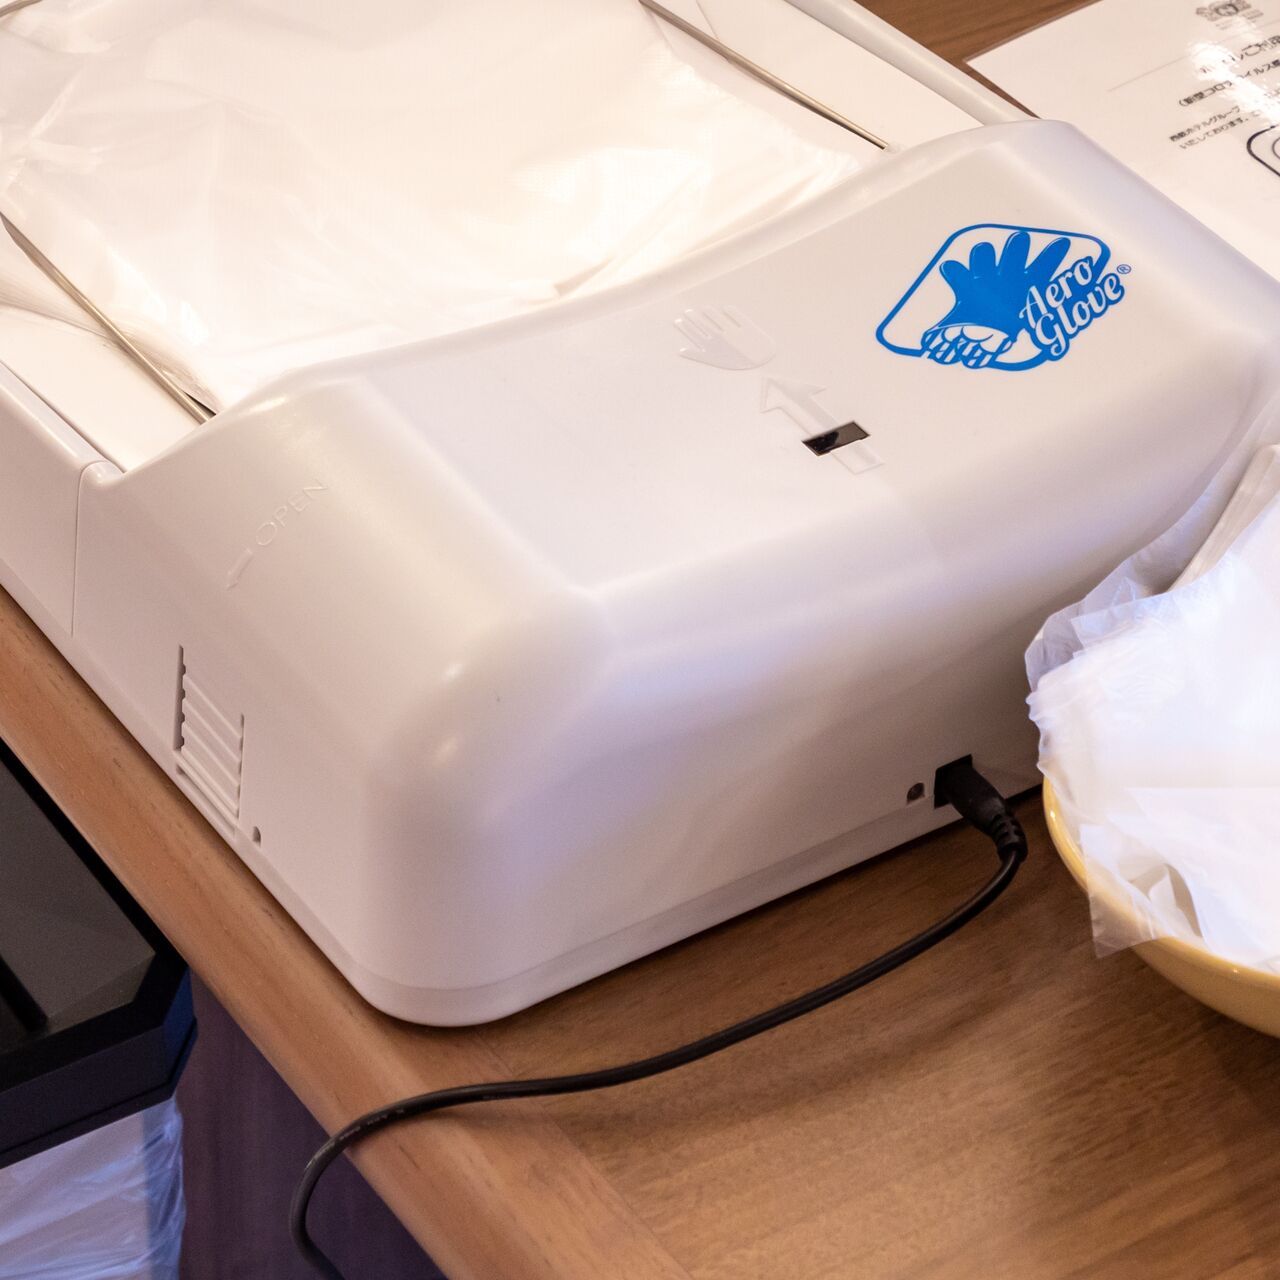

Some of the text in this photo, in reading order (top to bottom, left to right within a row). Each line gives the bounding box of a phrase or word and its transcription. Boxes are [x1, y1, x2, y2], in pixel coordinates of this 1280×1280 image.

[1018, 259, 1093, 330] Aero
[1034, 274, 1122, 357] Glove
[254, 477, 328, 547] OPEN
